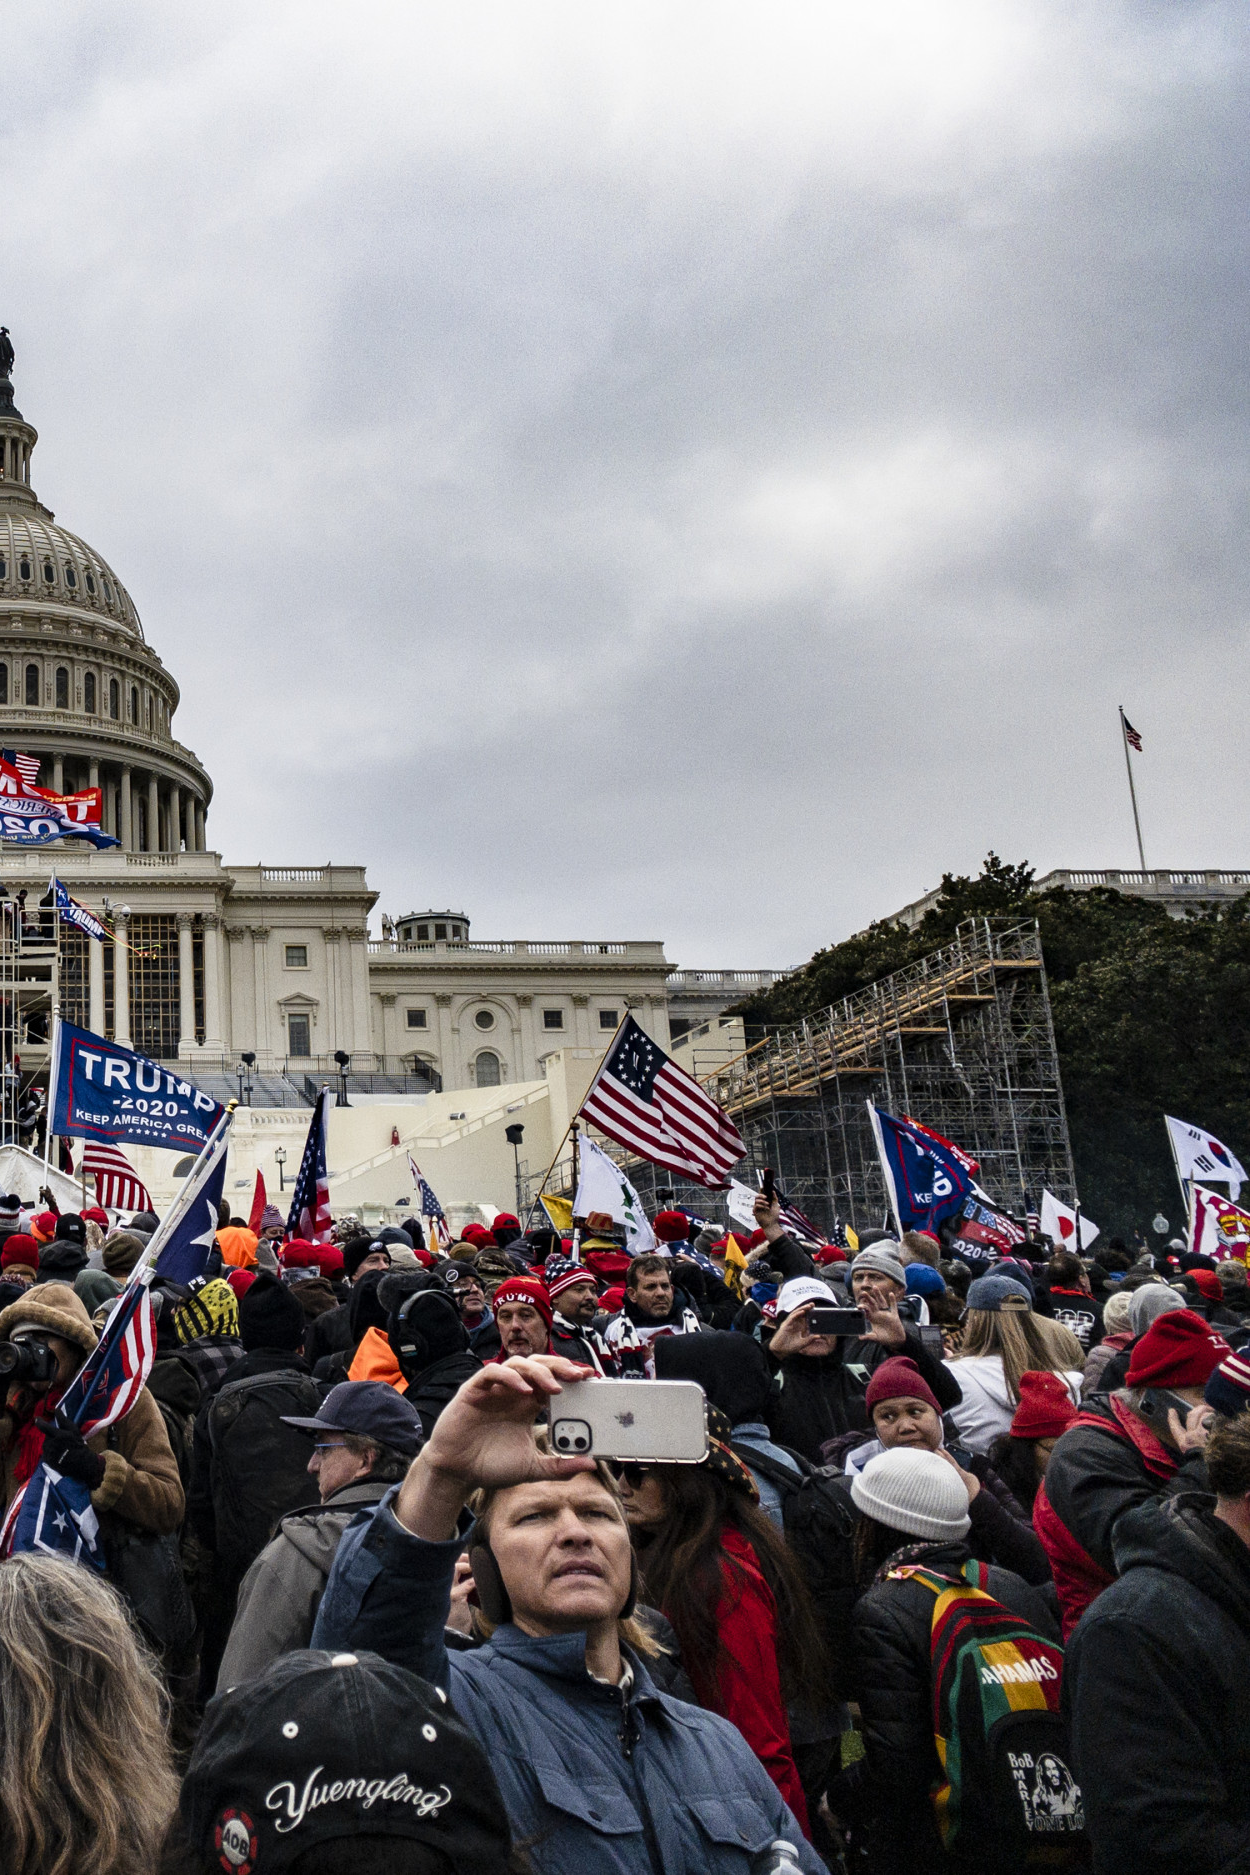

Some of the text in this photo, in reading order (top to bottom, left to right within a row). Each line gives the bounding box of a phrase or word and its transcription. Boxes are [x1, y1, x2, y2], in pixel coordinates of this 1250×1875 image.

[78, 1049, 216, 1113] TRUMP
[112, 1094, 189, 1117] -2020-
[76, 1108, 211, 1143] KEEP AMERICA GREA
[493, 1293, 535, 1308] TRUMP
[265, 1764, 452, 1833] Yuengling
[1012, 1769, 1034, 1832] MARLEY
[1034, 1812, 1086, 1832] ONE LO
